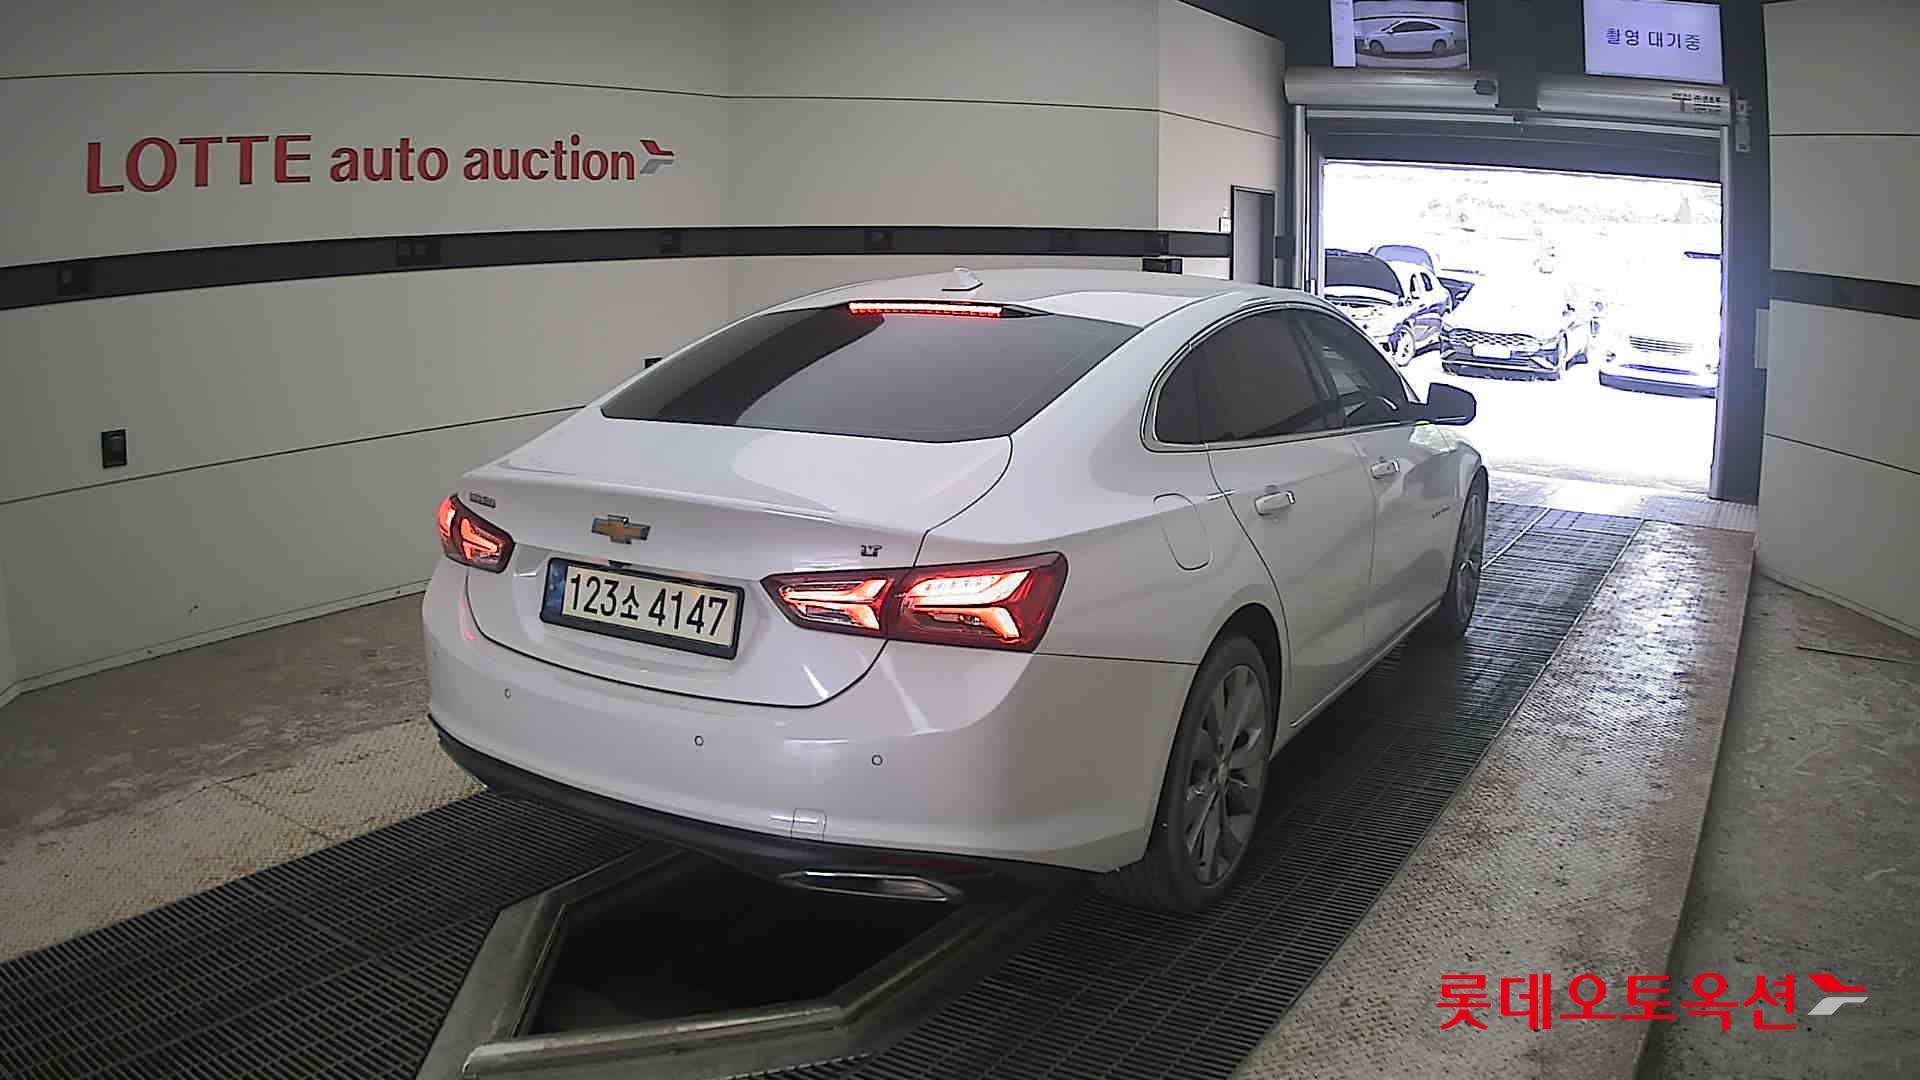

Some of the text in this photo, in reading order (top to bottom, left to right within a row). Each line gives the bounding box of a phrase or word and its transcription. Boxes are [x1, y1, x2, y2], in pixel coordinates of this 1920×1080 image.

[1648, 31, 1700, 51] 대기중
[86, 134, 635, 193] LOTTE auto auction
[570, 574, 729, 637] 123소 4147
